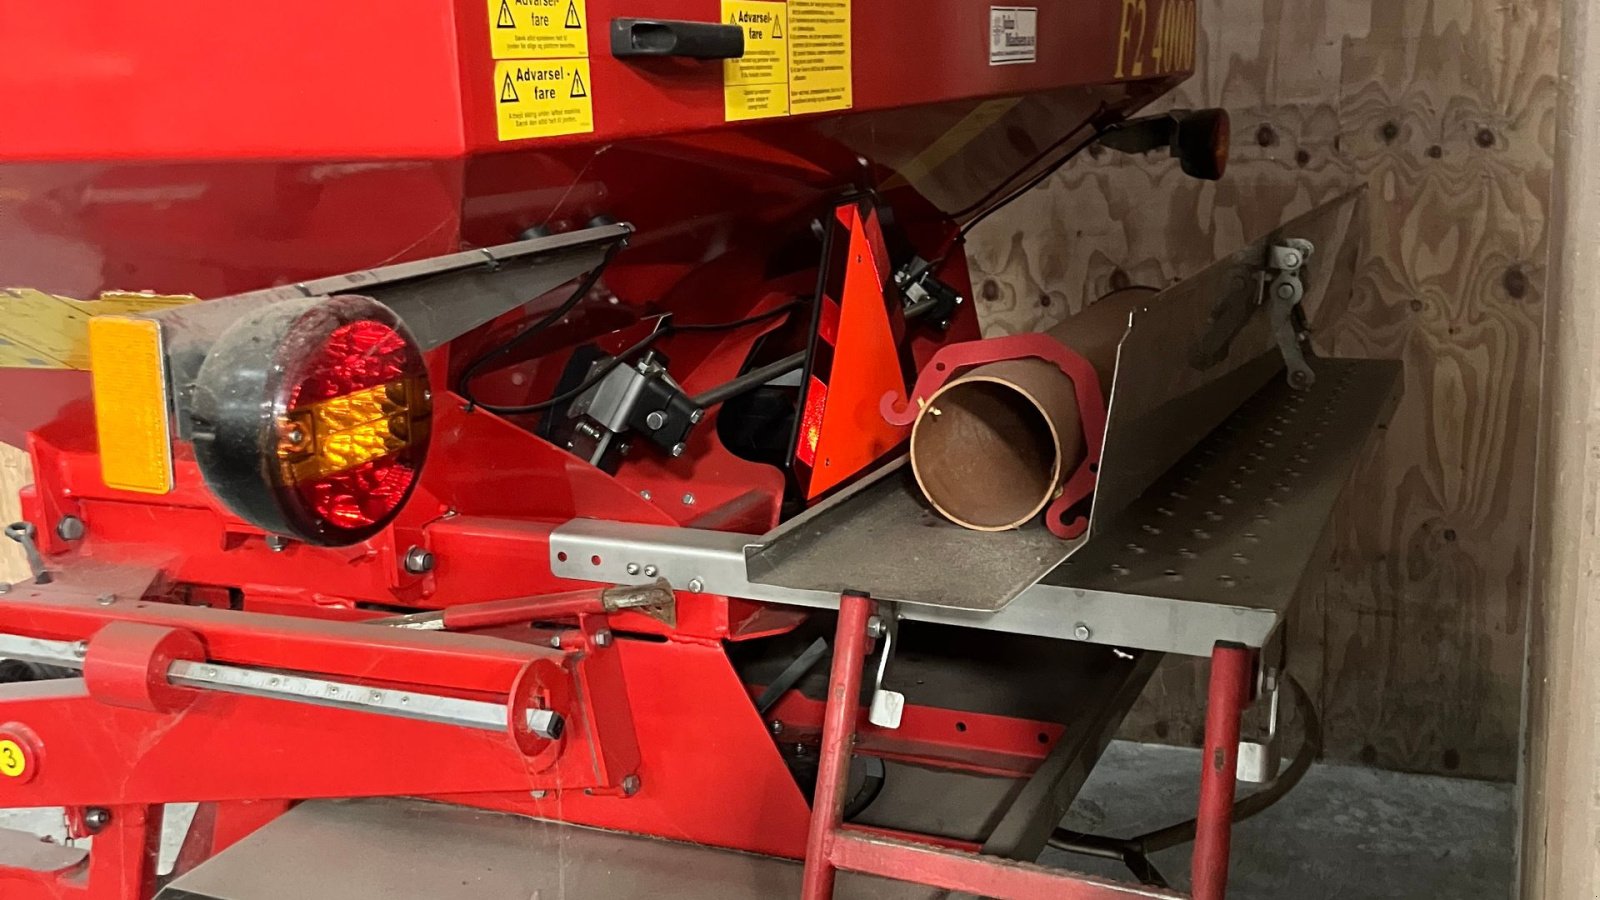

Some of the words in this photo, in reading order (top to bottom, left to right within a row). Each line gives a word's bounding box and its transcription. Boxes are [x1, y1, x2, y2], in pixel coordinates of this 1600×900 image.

[531, 12, 549, 27] fare
[748, 27, 763, 40] fare
[1152, 0, 1195, 75] 4000
[534, 86, 556, 100] fare
[3, 747, 17, 769] 3
